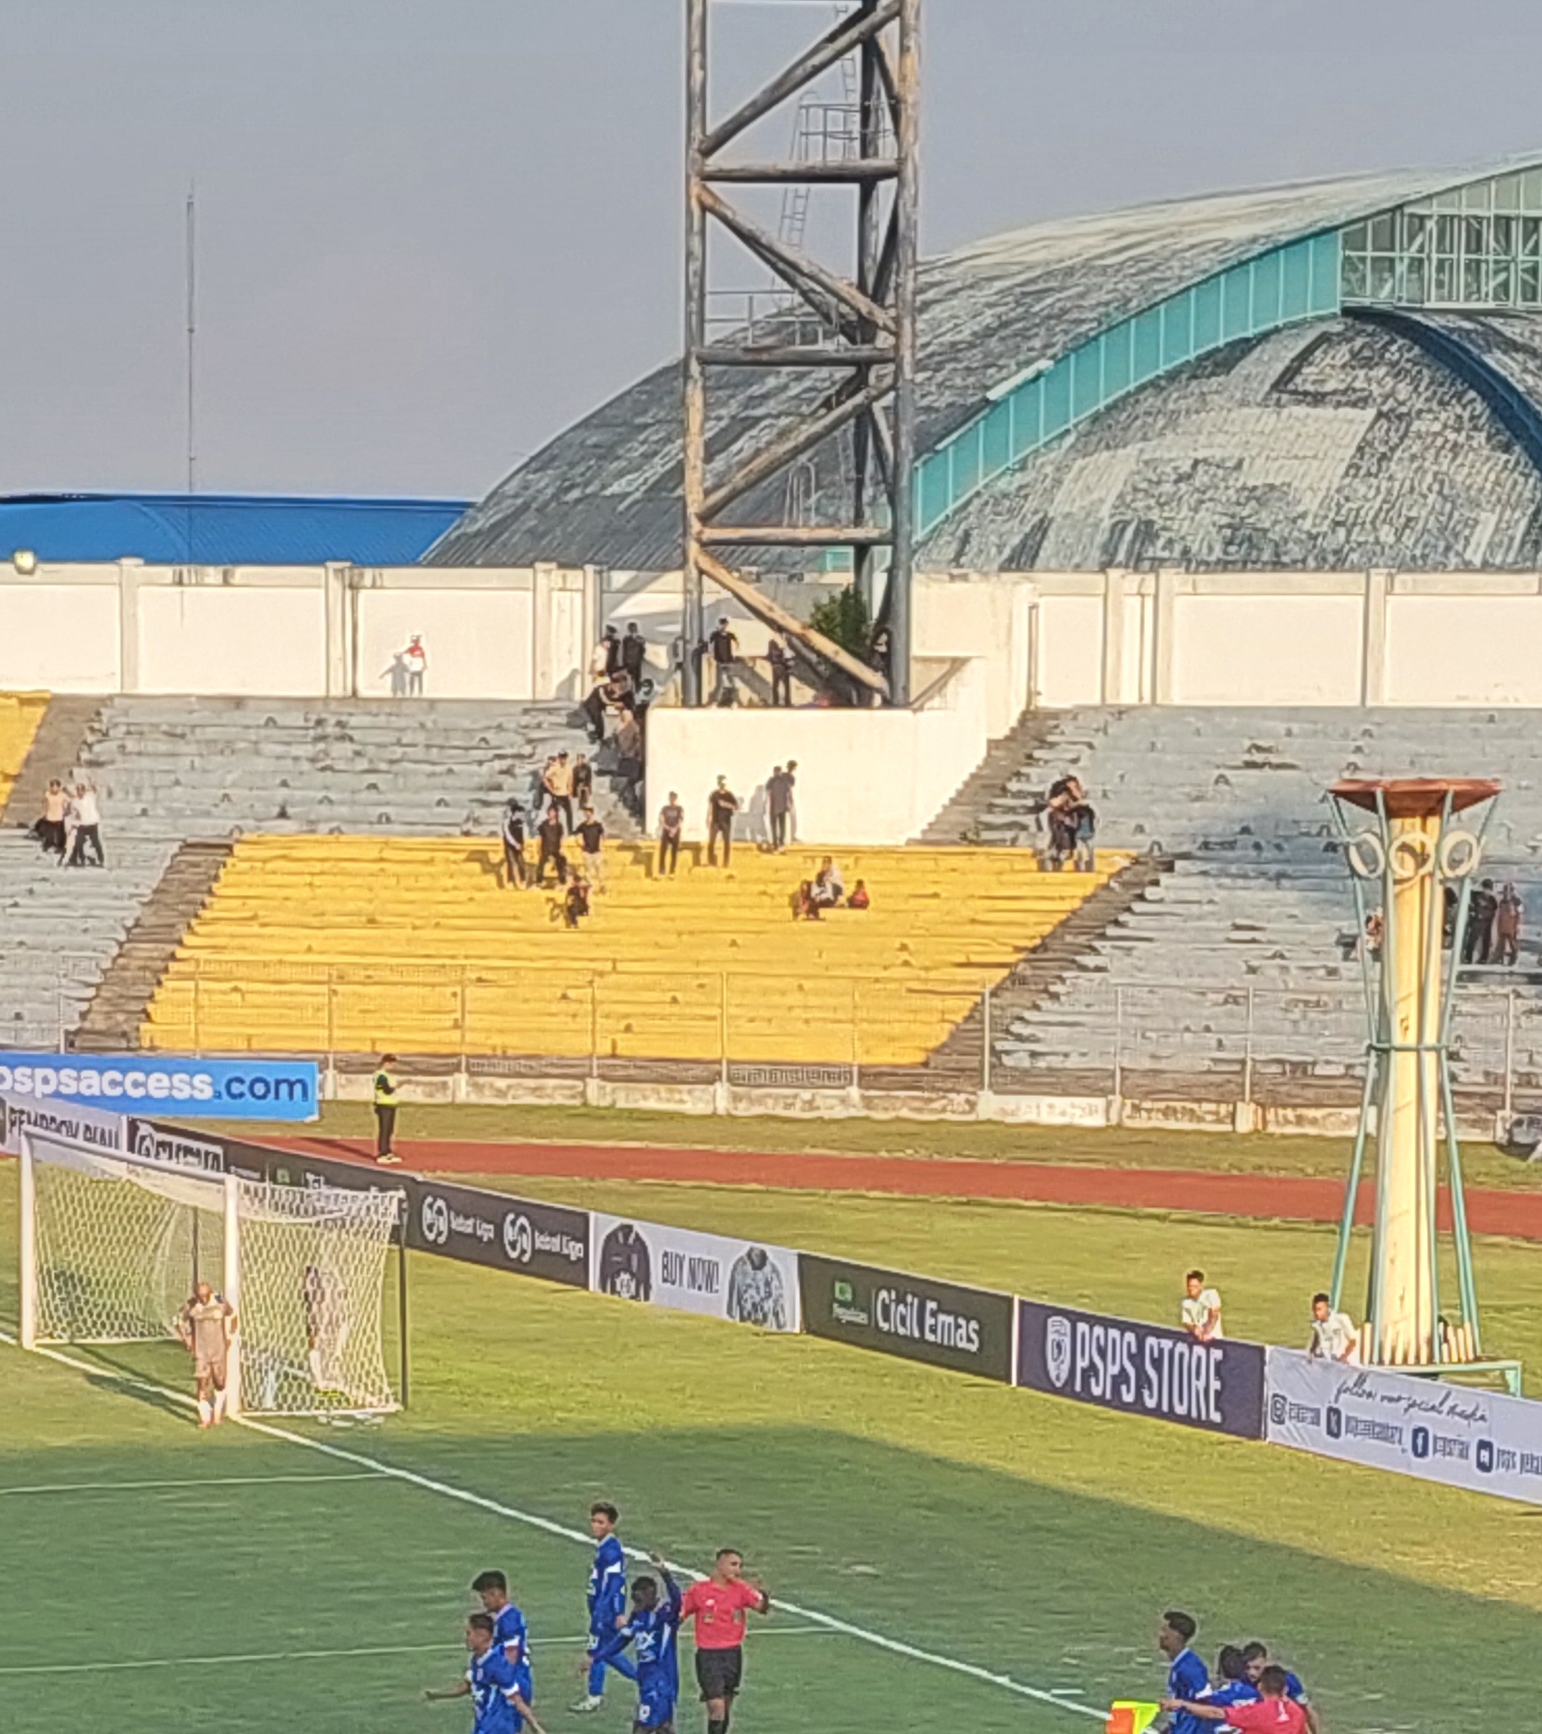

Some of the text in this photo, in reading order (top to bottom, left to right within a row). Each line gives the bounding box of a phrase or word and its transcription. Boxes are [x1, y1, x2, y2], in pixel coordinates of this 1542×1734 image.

[662, 1250, 719, 1294] BUY NOW!
[876, 1289, 980, 1353] Cicil Emas
[1074, 1322, 1224, 1424] PSPS STORE
